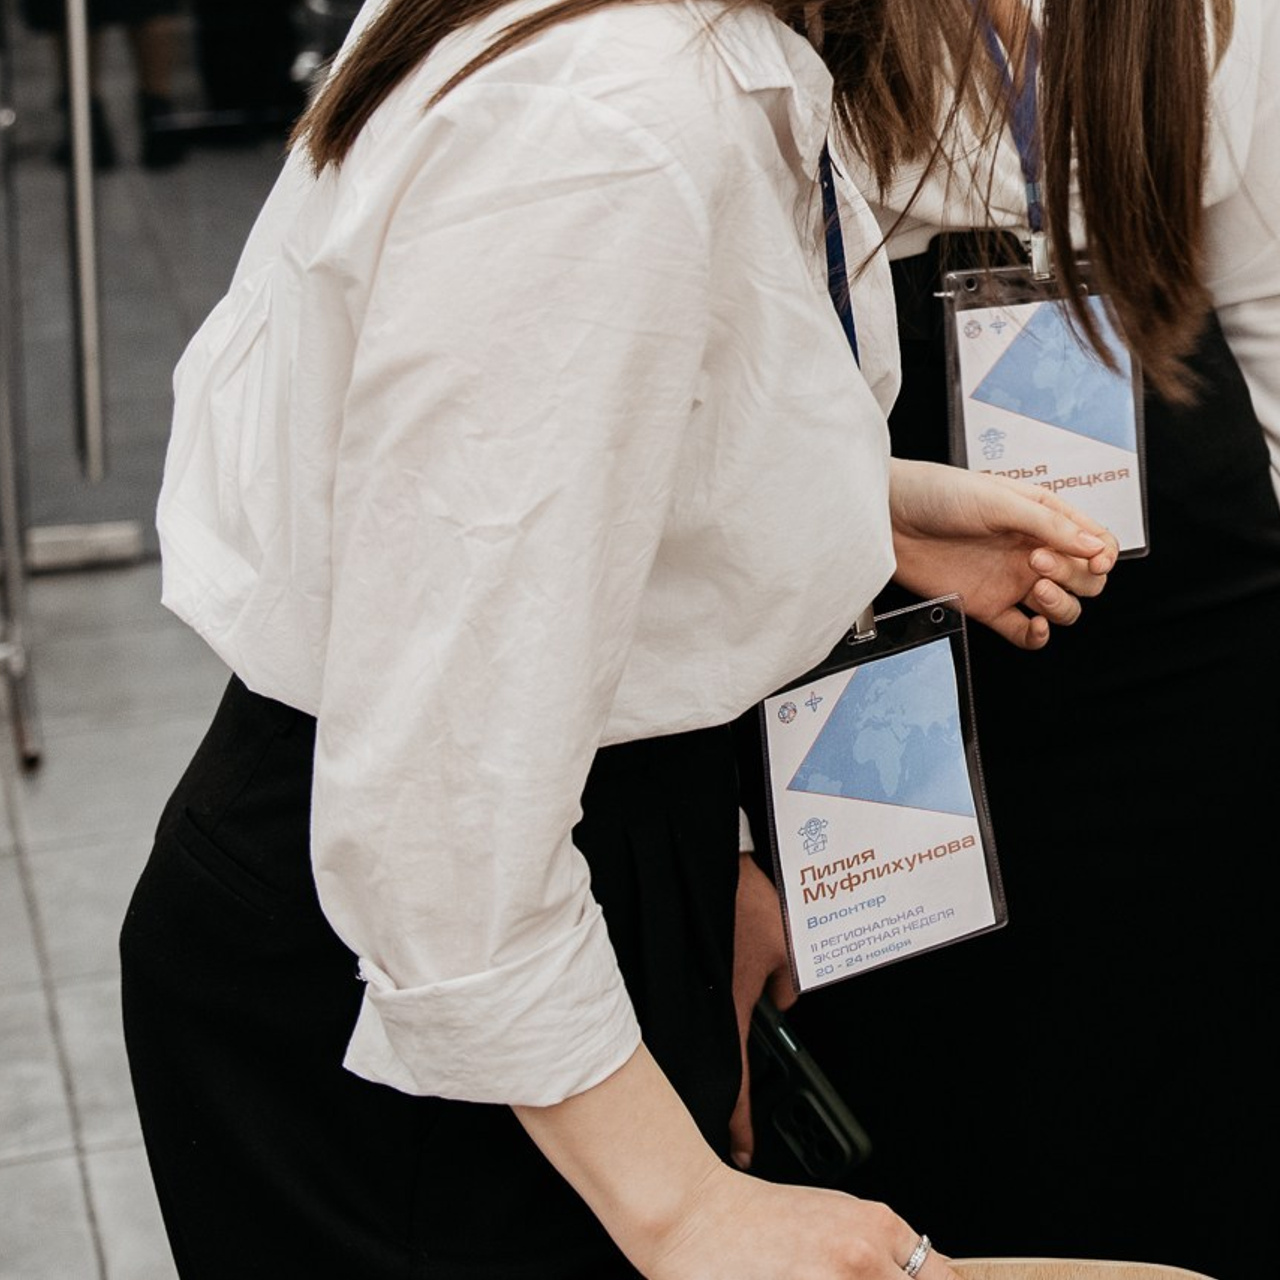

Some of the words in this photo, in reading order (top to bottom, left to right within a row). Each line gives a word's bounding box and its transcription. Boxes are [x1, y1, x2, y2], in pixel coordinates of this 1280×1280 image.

[800, 848, 876, 886] Лилия
[802, 834, 976, 905] Муфлихунова
[807, 894, 887, 930] Волонтер
[820, 905, 925, 949] РЕГИОНАЛЬНАЯ
[813, 928, 901, 965] ЭКСПОРТНАЯ
[903, 907, 955, 934] НЕДЕЛЯ
[816, 964, 835, 979] 20
[845, 954, 863, 968] 24
[865, 938, 912, 961] ноября
